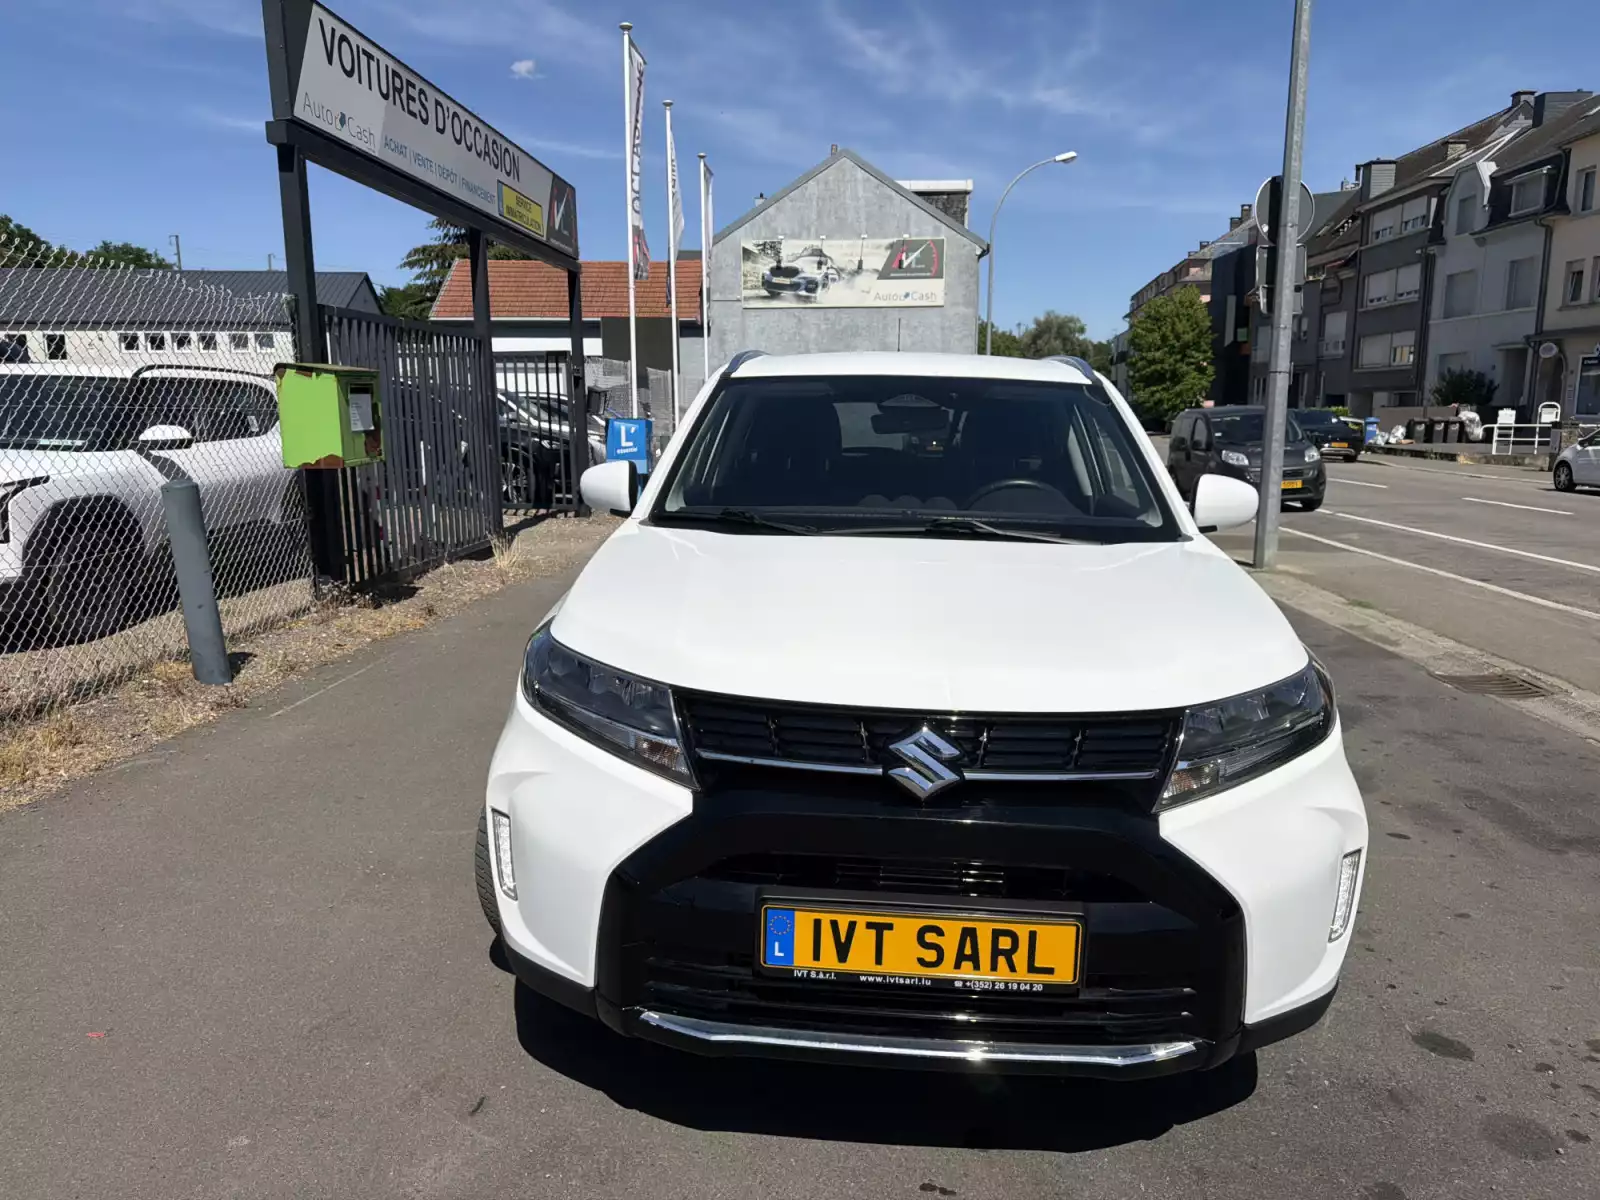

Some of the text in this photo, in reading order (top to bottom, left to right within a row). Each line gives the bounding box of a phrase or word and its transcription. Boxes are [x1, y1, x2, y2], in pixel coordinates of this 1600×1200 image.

[318, 18, 520, 183] VOITURES D'OCCASION
[302, 91, 376, 149] Auto Cash
[384, 135, 408, 158] ACHAT
[412, 151, 433, 173] VENTE
[462, 178, 496, 204] FINANCEMENT
[874, 291, 937, 302] Auto Cash
[774, 941, 785, 957] L
[812, 918, 1055, 975] IVT SARL
[793, 969, 808, 978] IVT
[859, 975, 932, 986] www.ivtsarl.lu
[965, 980, 1043, 991] +(352) 26 19 04 20
